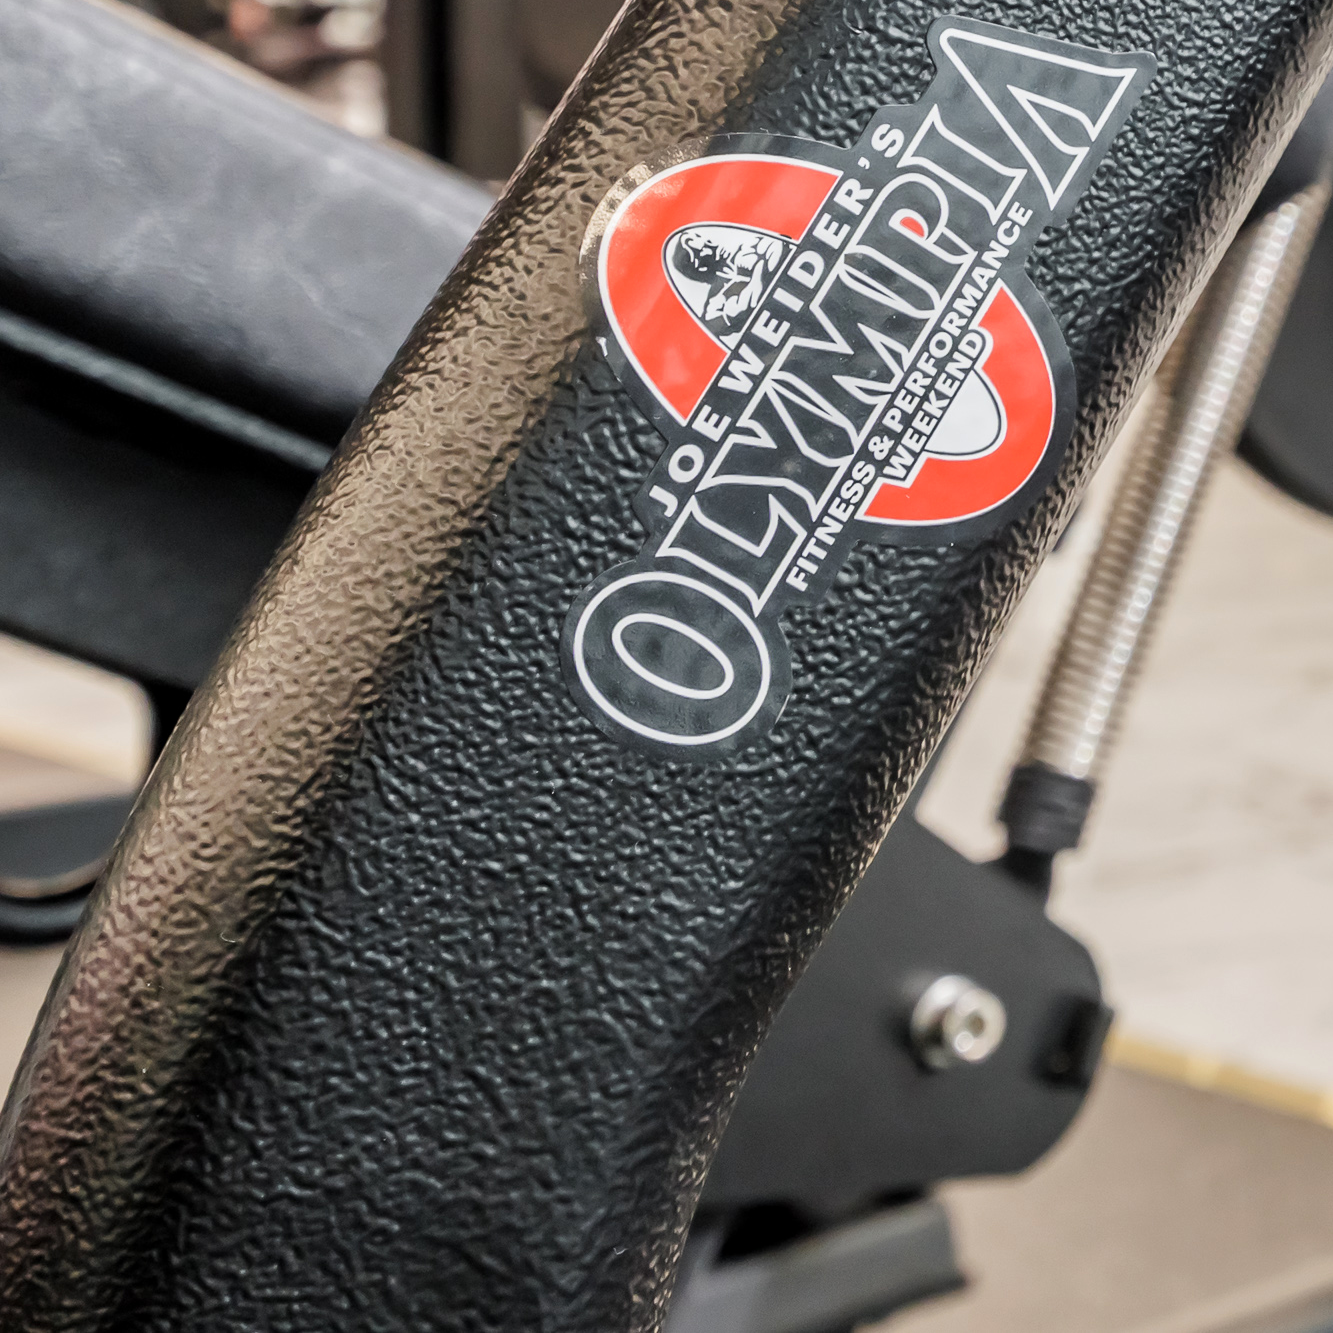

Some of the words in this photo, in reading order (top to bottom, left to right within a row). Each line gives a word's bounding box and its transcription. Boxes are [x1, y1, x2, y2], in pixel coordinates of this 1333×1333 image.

[573, 27, 1138, 746] OLYMPIA
[649, 405, 731, 518] JOE
[718, 124, 905, 395] WEIDER'S
[786, 461, 876, 592] FITNESS
[868, 436, 895, 461] &
[882, 201, 1033, 433] PERFORMANCE
[882, 330, 984, 479] WEEKEND
